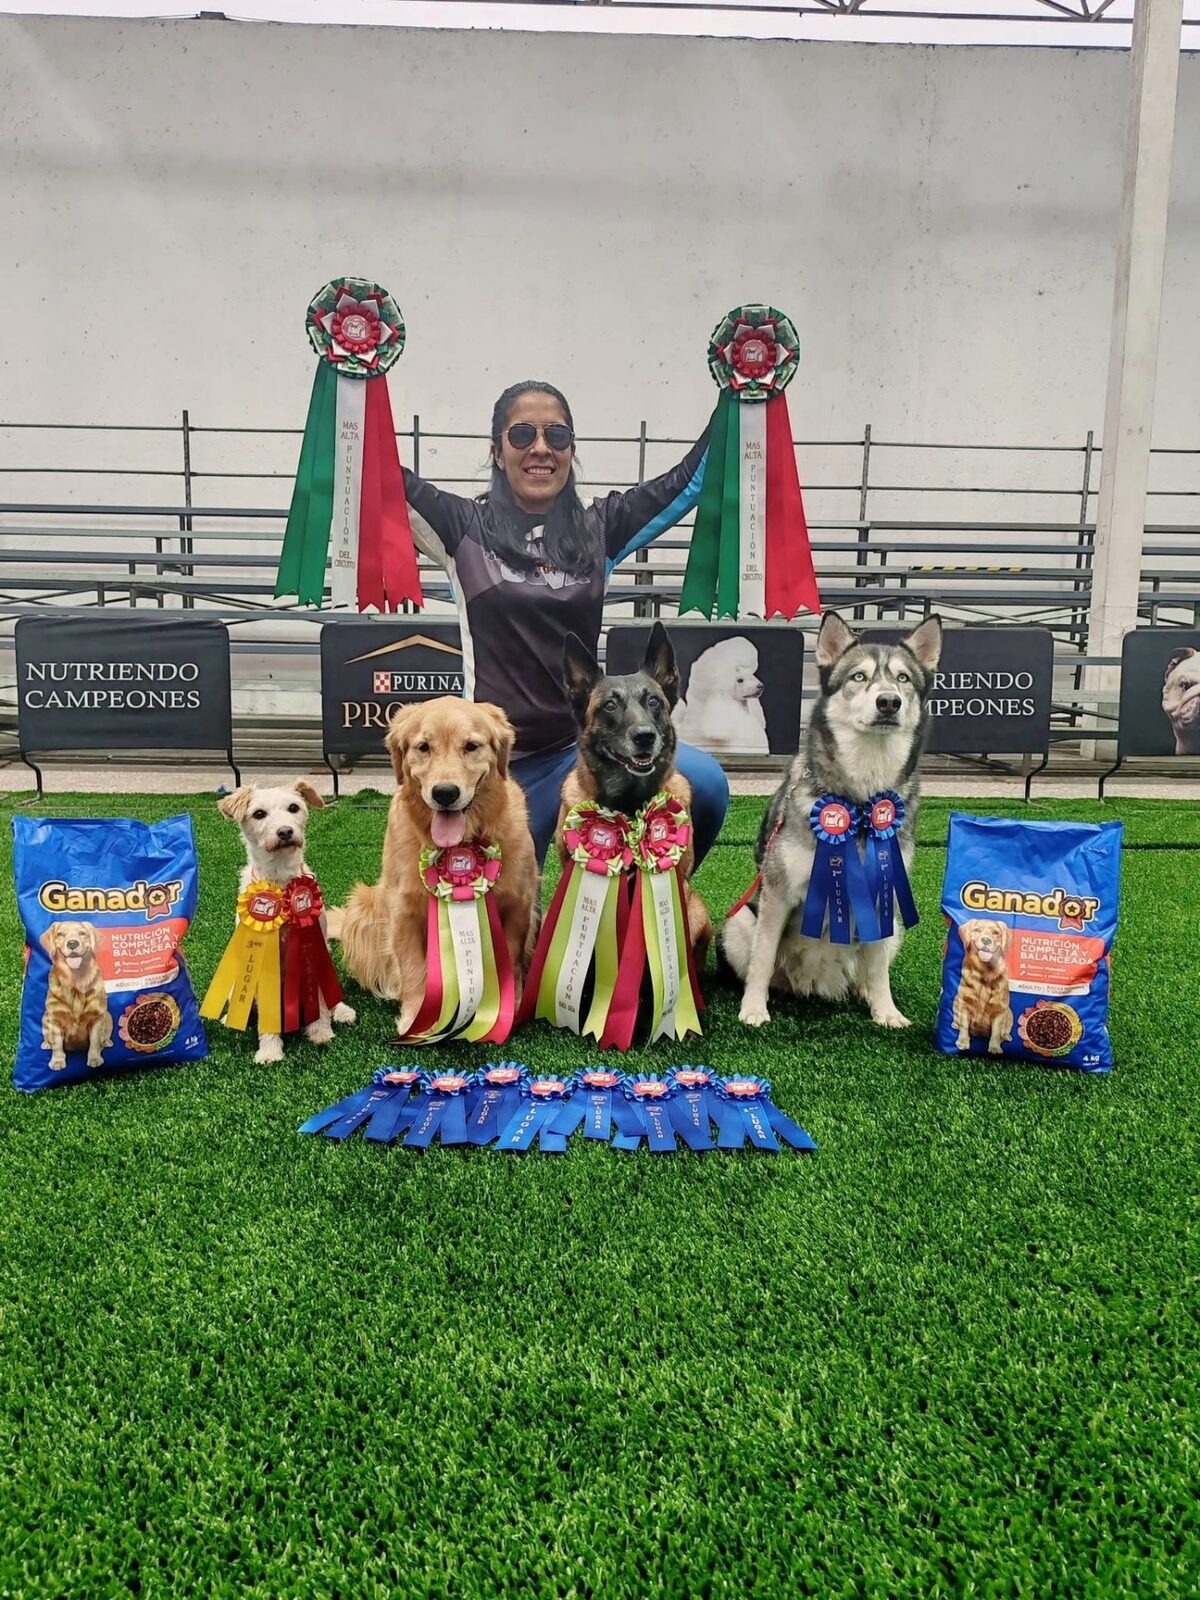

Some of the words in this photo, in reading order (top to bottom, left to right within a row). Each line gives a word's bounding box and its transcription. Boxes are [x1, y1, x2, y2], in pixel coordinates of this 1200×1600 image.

[343, 421, 358, 430] MAS
[341, 432, 359, 440] ALTA
[746, 442, 760, 450] MAS
[744, 452, 762, 460] ALTA
[25, 662, 199, 682] NUTRIENDO
[393, 675, 463, 691] PURINA
[931, 671, 1034, 690] RIENDO
[25, 690, 201, 709] CAMPEONES
[39, 880, 183, 914] Ganador
[961, 880, 1099, 921] Ganador
[111, 927, 171, 942] NUTRICIÓN
[112, 935, 170, 950] COMPLETA
[173, 933, 180, 941] Y
[113, 942, 179, 957] BALANCEAD
[1021, 936, 1079, 950] NUTRICIÓN
[1020, 944, 1078, 956] COMPLETA
[1080, 950, 1089, 958] Y
[1020, 951, 1094, 965] BALANCEADA
[239, 954, 254, 1003] LUGAR
[510, 1108, 537, 1143] LUGAR
